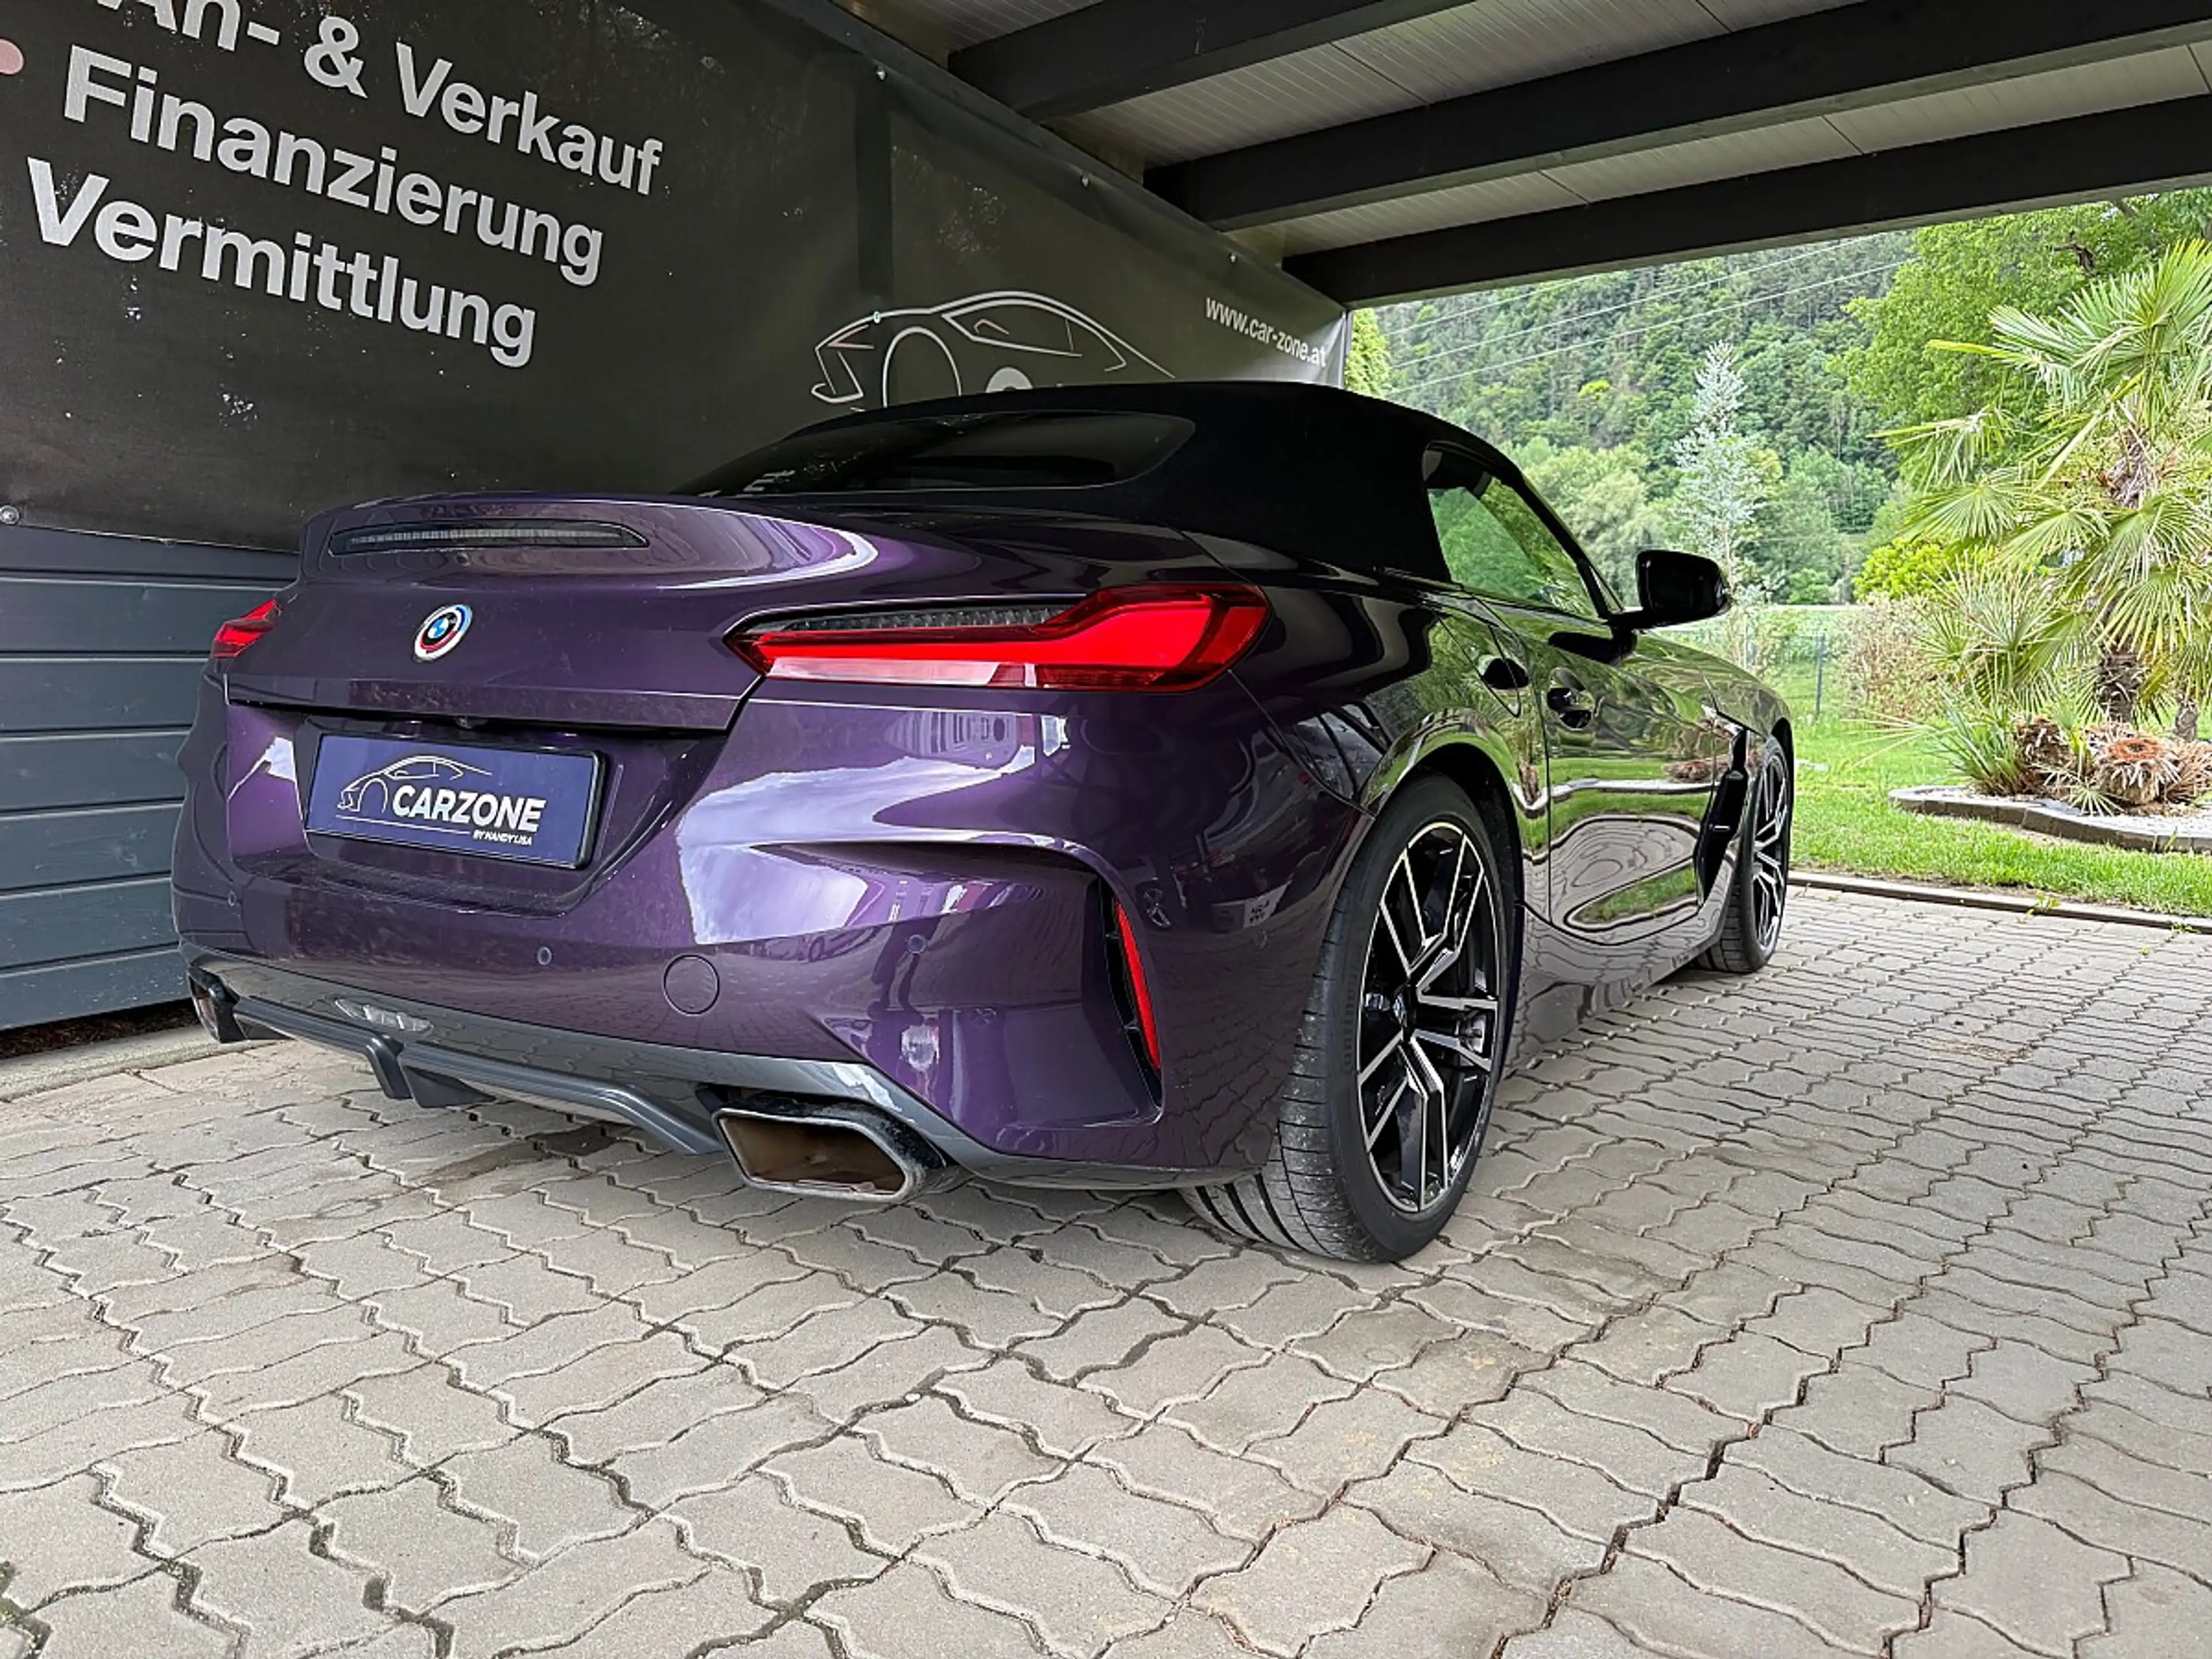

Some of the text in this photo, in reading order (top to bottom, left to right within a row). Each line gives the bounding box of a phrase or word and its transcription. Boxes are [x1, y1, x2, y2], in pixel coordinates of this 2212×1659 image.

[64, 44, 603, 286] Finanzierung
[304, 14, 368, 99] &
[396, 41, 662, 195] Verkauf
[27, 156, 535, 368] Vermittlung
[1205, 297, 1326, 367] www.car-zone.at
[392, 785, 547, 832] CARZONE
